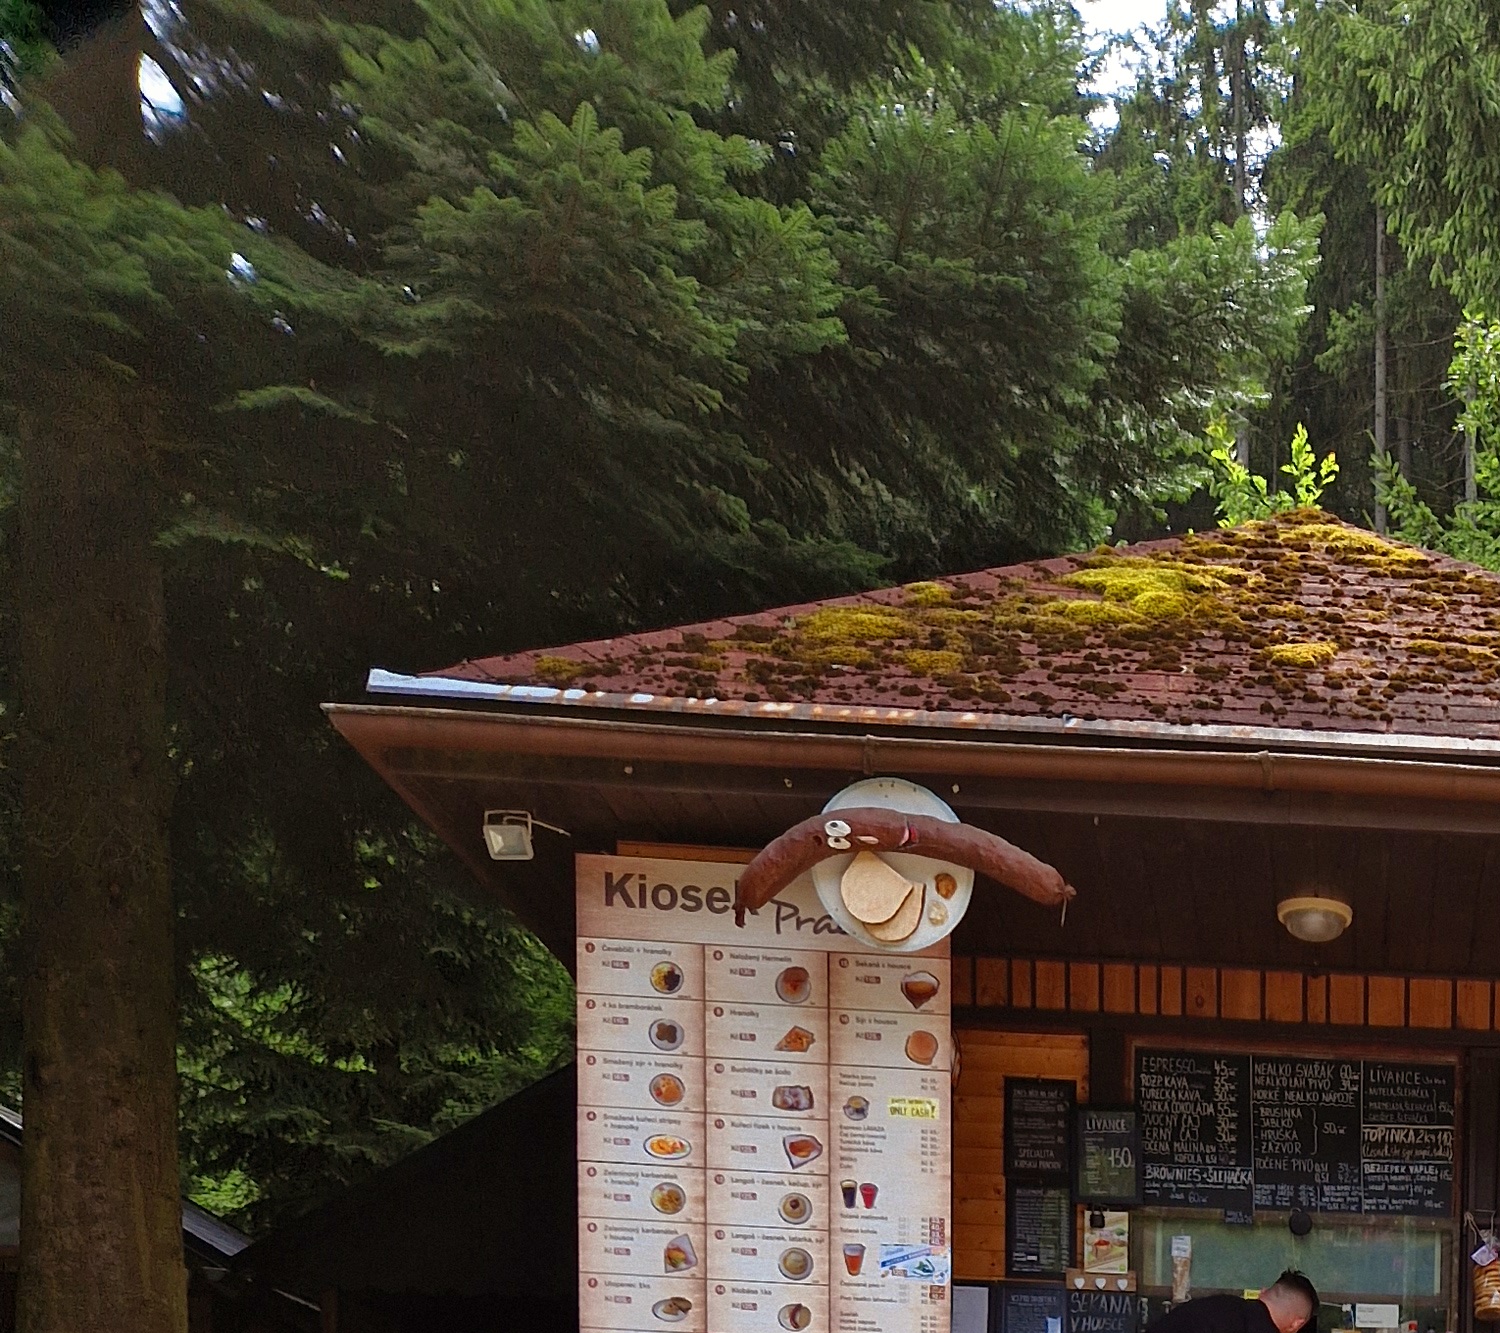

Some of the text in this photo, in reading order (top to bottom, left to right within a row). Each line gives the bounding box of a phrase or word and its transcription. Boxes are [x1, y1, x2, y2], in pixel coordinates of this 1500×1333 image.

[1142, 1057, 1196, 1074] ESPRESSO
[1255, 1063, 1291, 1077] NEALKO
[1370, 1065, 1420, 1084] LÍVANCE
[1285, 1091, 1319, 1102] NEALKO
[1086, 1114, 1126, 1131] LÍVANCE
[1363, 1128, 1416, 1144] TOPINKA
[1144, 1165, 1200, 1181] BROWNIES
[1291, 1159, 1313, 1172] PIVO
[1081, 1316, 1123, 1331] HOUSCE
